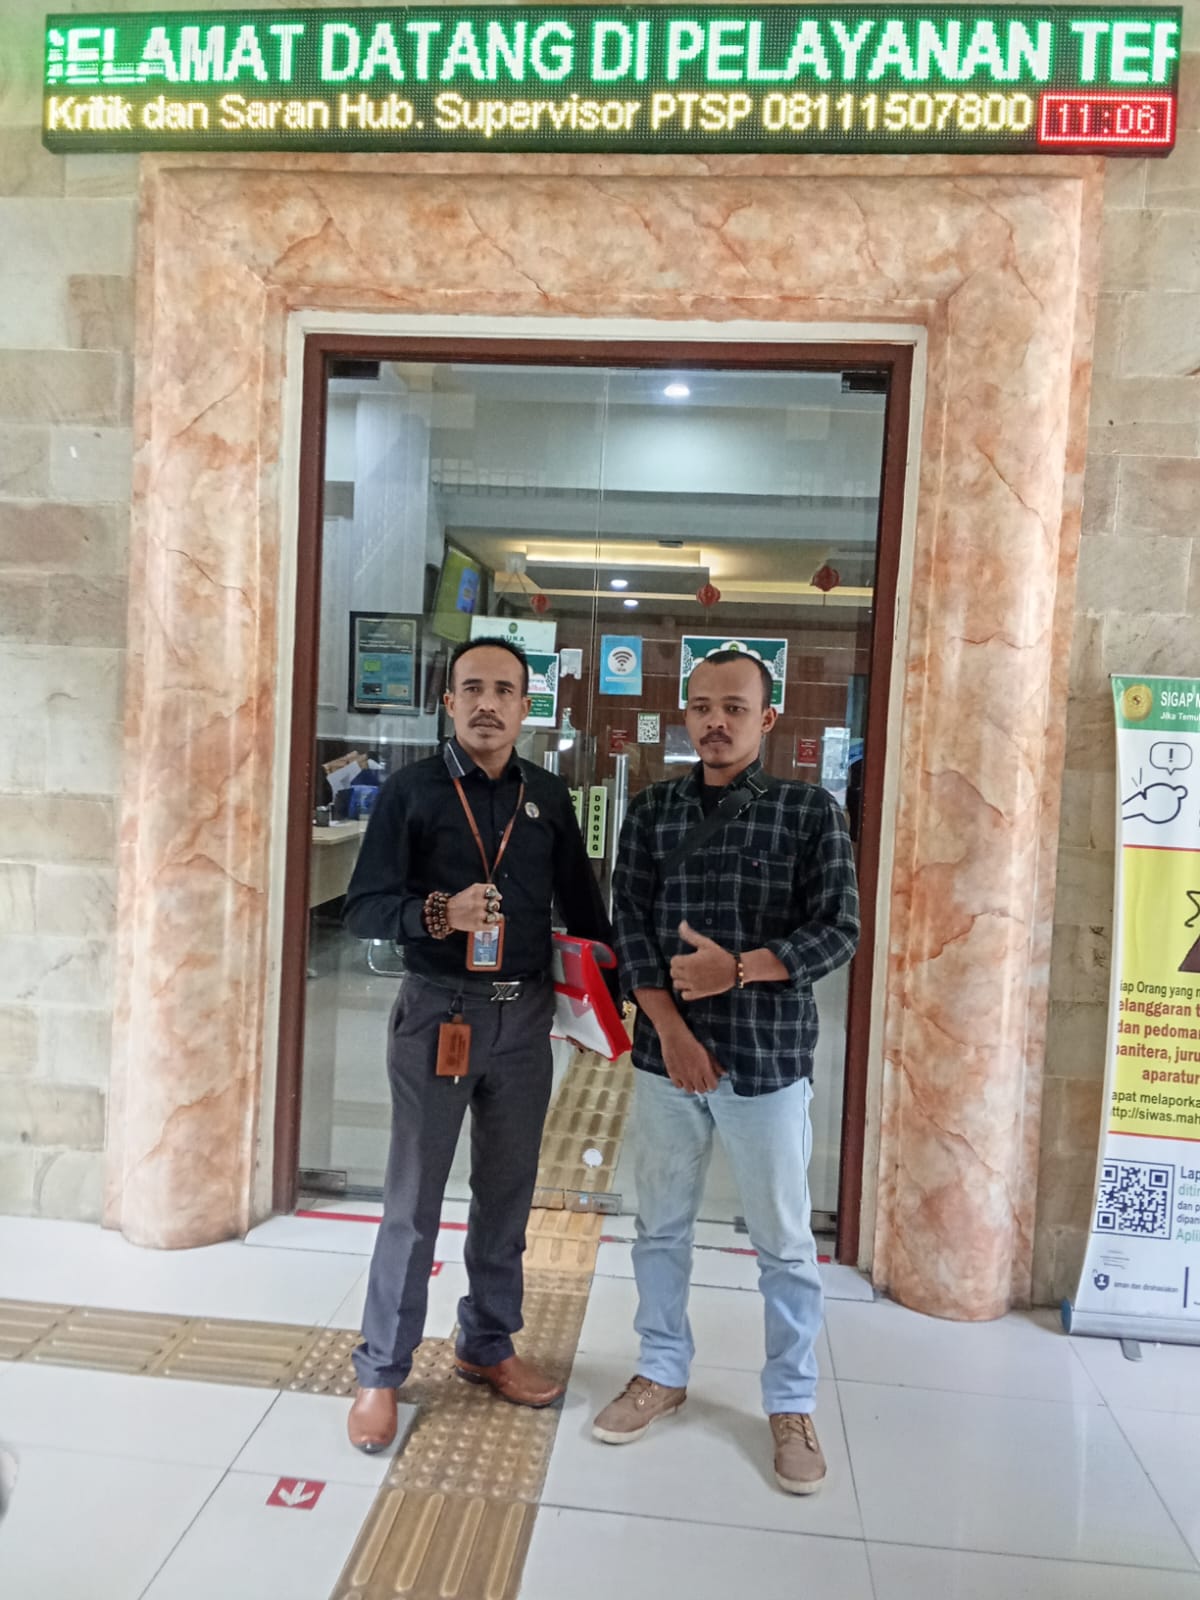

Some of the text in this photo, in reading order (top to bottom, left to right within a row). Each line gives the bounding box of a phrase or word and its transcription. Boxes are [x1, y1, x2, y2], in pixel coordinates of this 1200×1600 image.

[321, 21, 574, 81] DATANG
[591, 21, 650, 81] DI
[667, 20, 1051, 81] PELAYANAN
[48, 92, 1032, 137] Kritik dan Saran Hub. Supervisor PTSP 08111507800
[1058, 103, 1156, 135] 11:06
[1160, 690, 1193, 708] SIGAP
[592, 794, 601, 852] DORONG
[1136, 980, 1167, 998] Orang
[1168, 985, 1193, 1000] yang
[1177, 1200, 1193, 1211] dan
